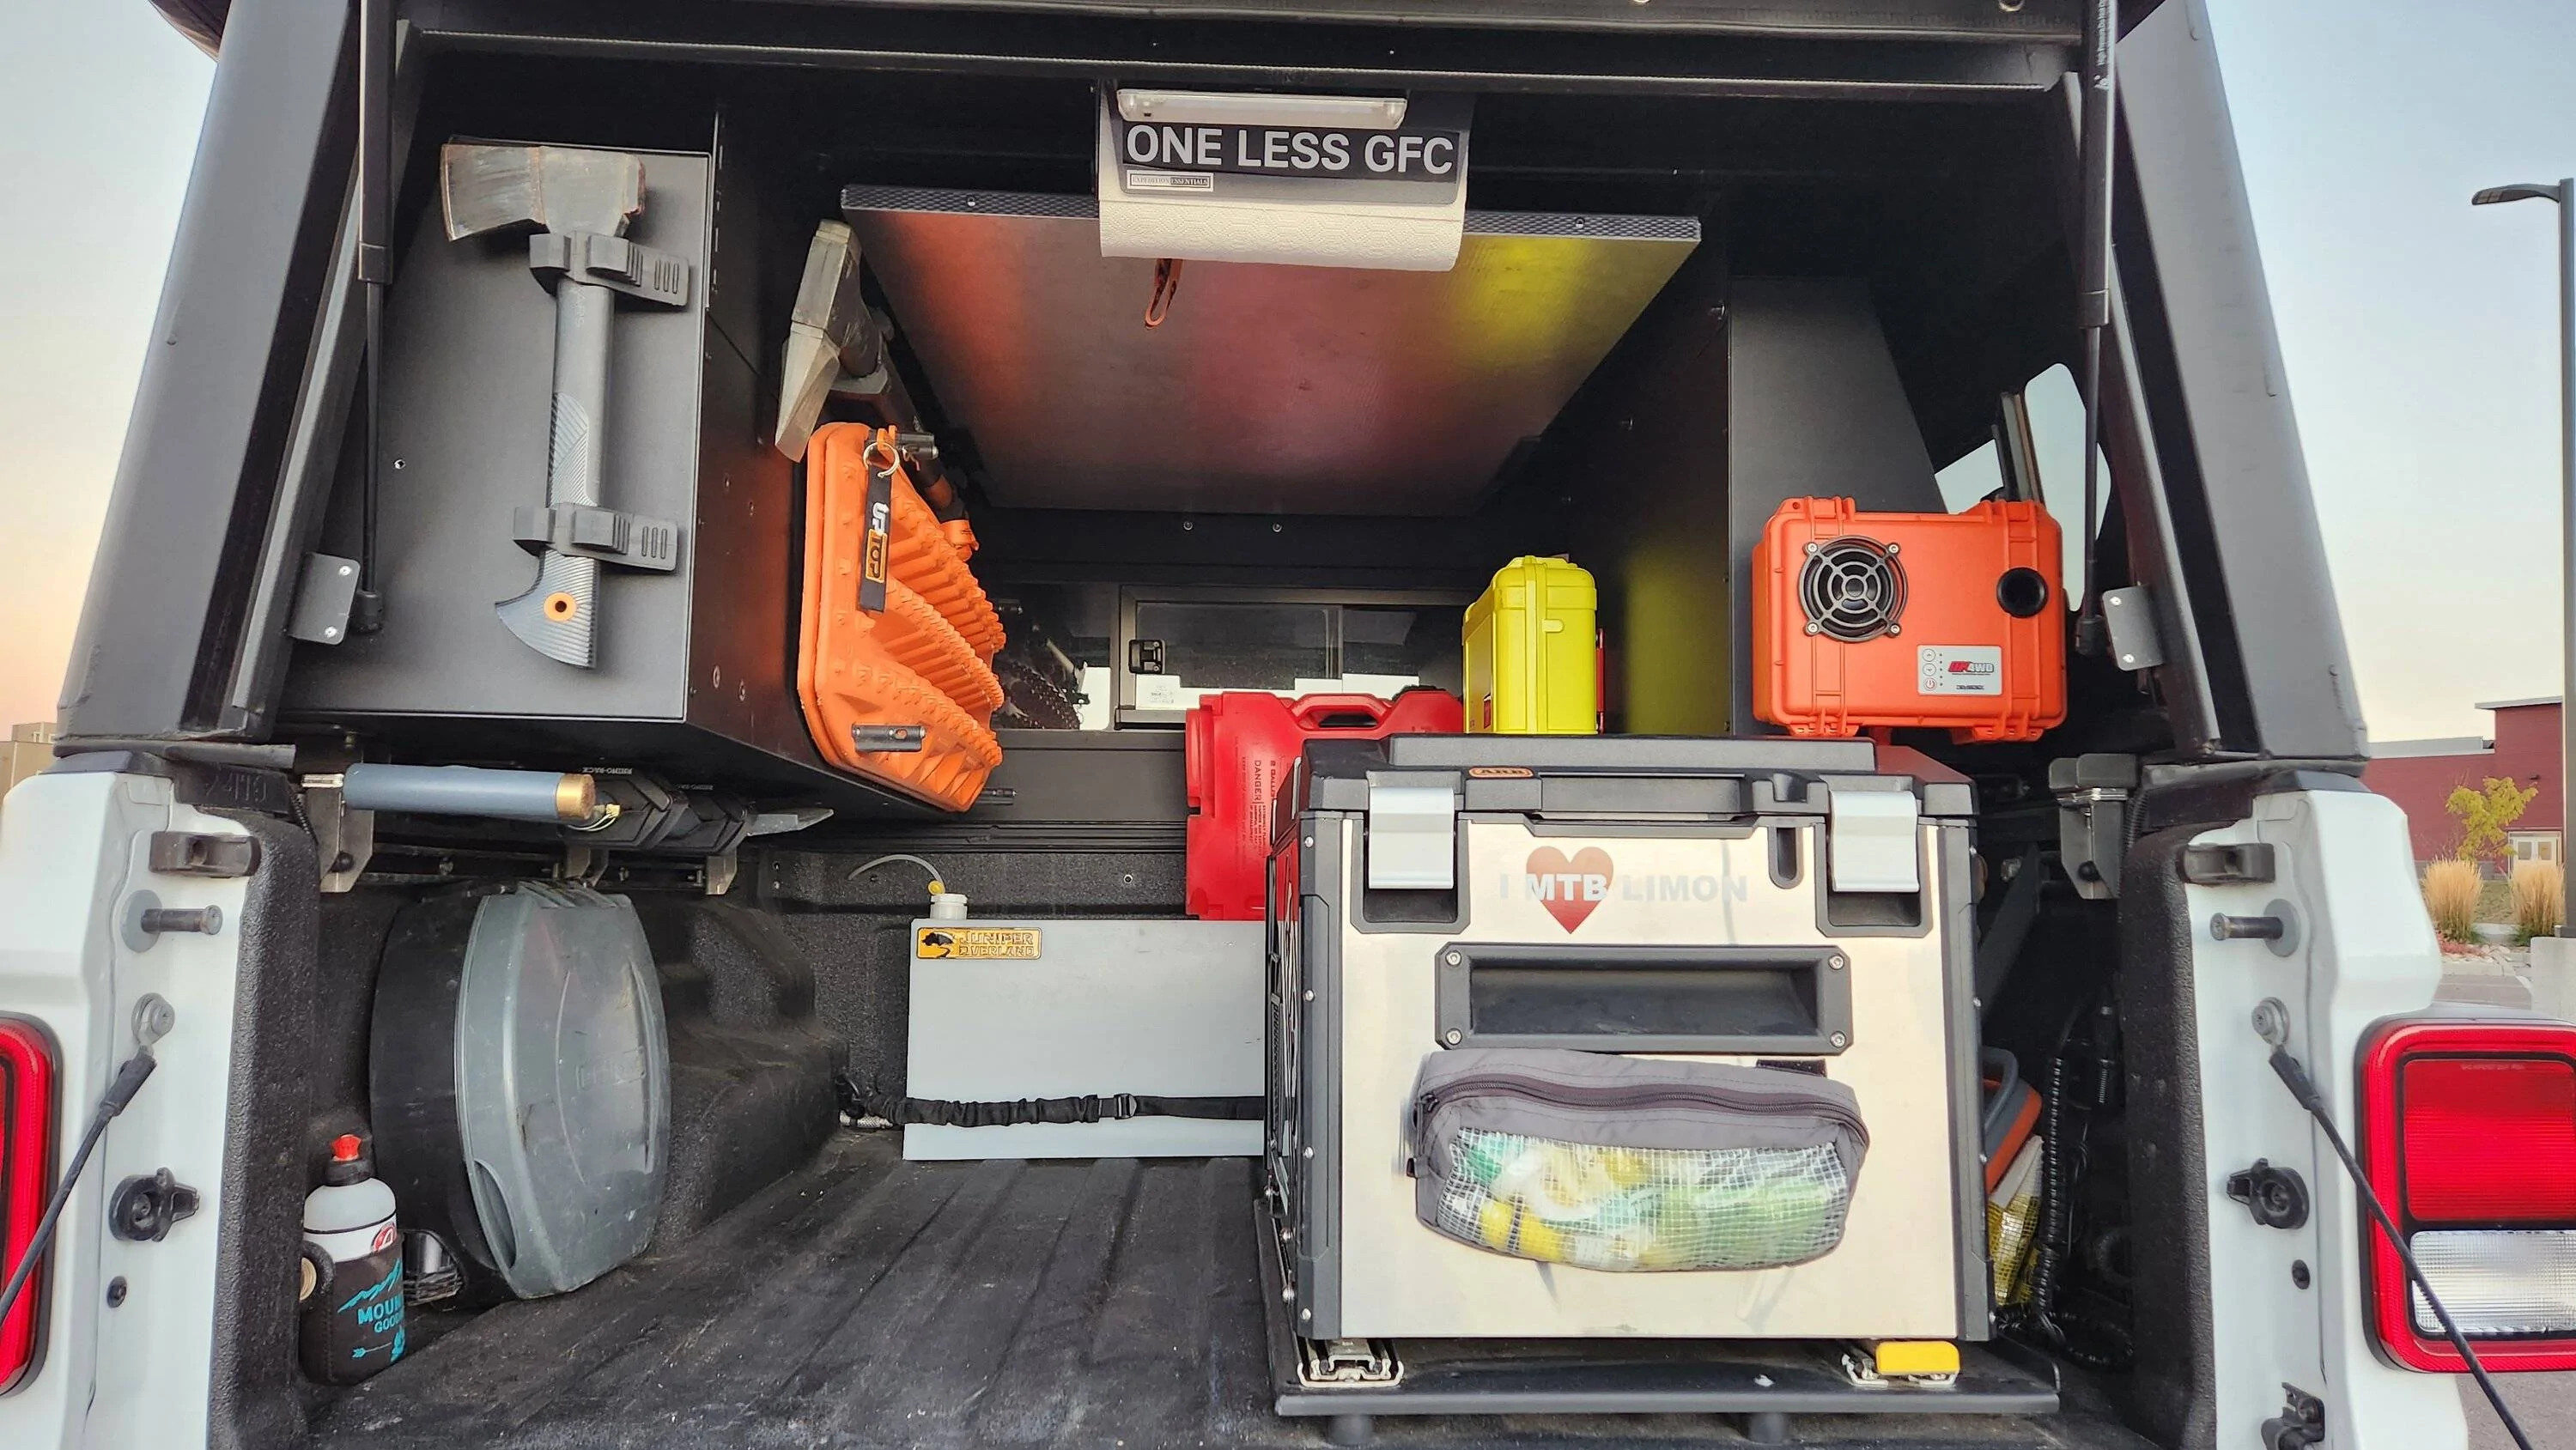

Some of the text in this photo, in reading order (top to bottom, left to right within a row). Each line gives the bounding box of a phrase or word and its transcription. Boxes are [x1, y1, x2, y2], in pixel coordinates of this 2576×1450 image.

[1127, 124, 1454, 174] ONE LESS GFC
[1170, 177, 1208, 185] ESSENTIALS
[1254, 760, 1262, 801] DANGER
[1525, 873, 1607, 901] MTB
[1622, 875, 1748, 901] LIMON
[959, 931, 1034, 944] JUNIPER
[959, 946, 1035, 956] OVERLAND
